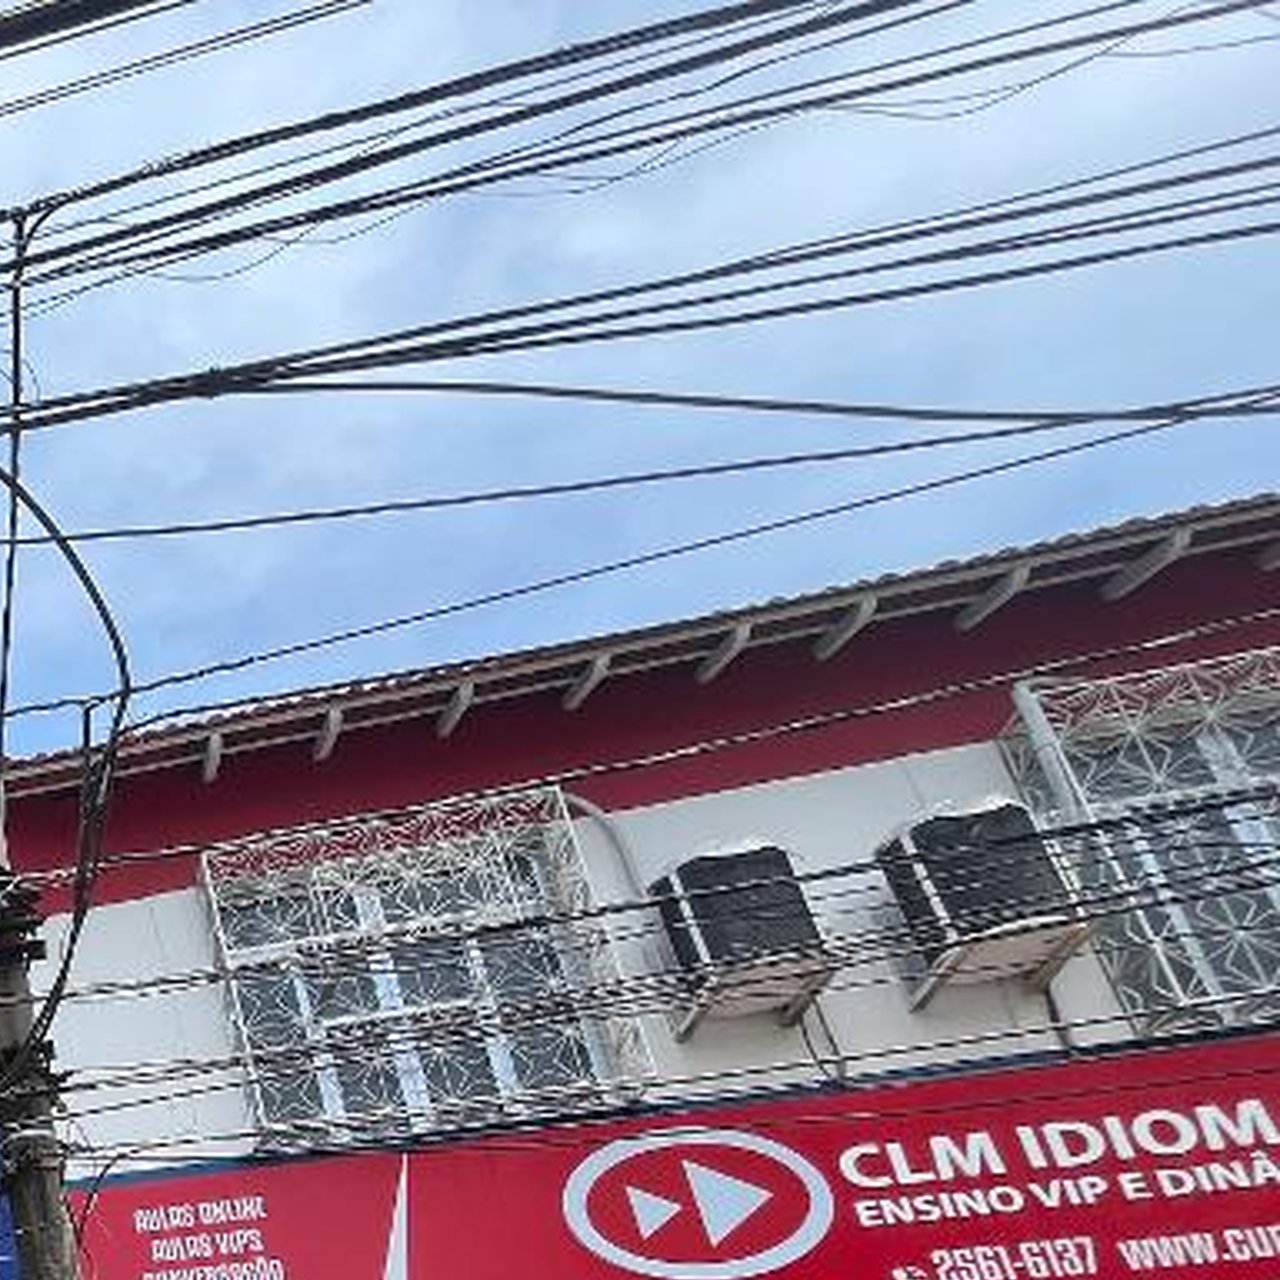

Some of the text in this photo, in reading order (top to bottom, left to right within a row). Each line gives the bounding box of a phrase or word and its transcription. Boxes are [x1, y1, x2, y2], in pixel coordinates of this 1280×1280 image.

[839, 1099, 1280, 1188] CLM IDIOM
[855, 1185, 1024, 1227] ENSINO
[1028, 1175, 1108, 1208] VIP
[1118, 1171, 1154, 1200] E
[215, 1228, 264, 1254] VIPS
